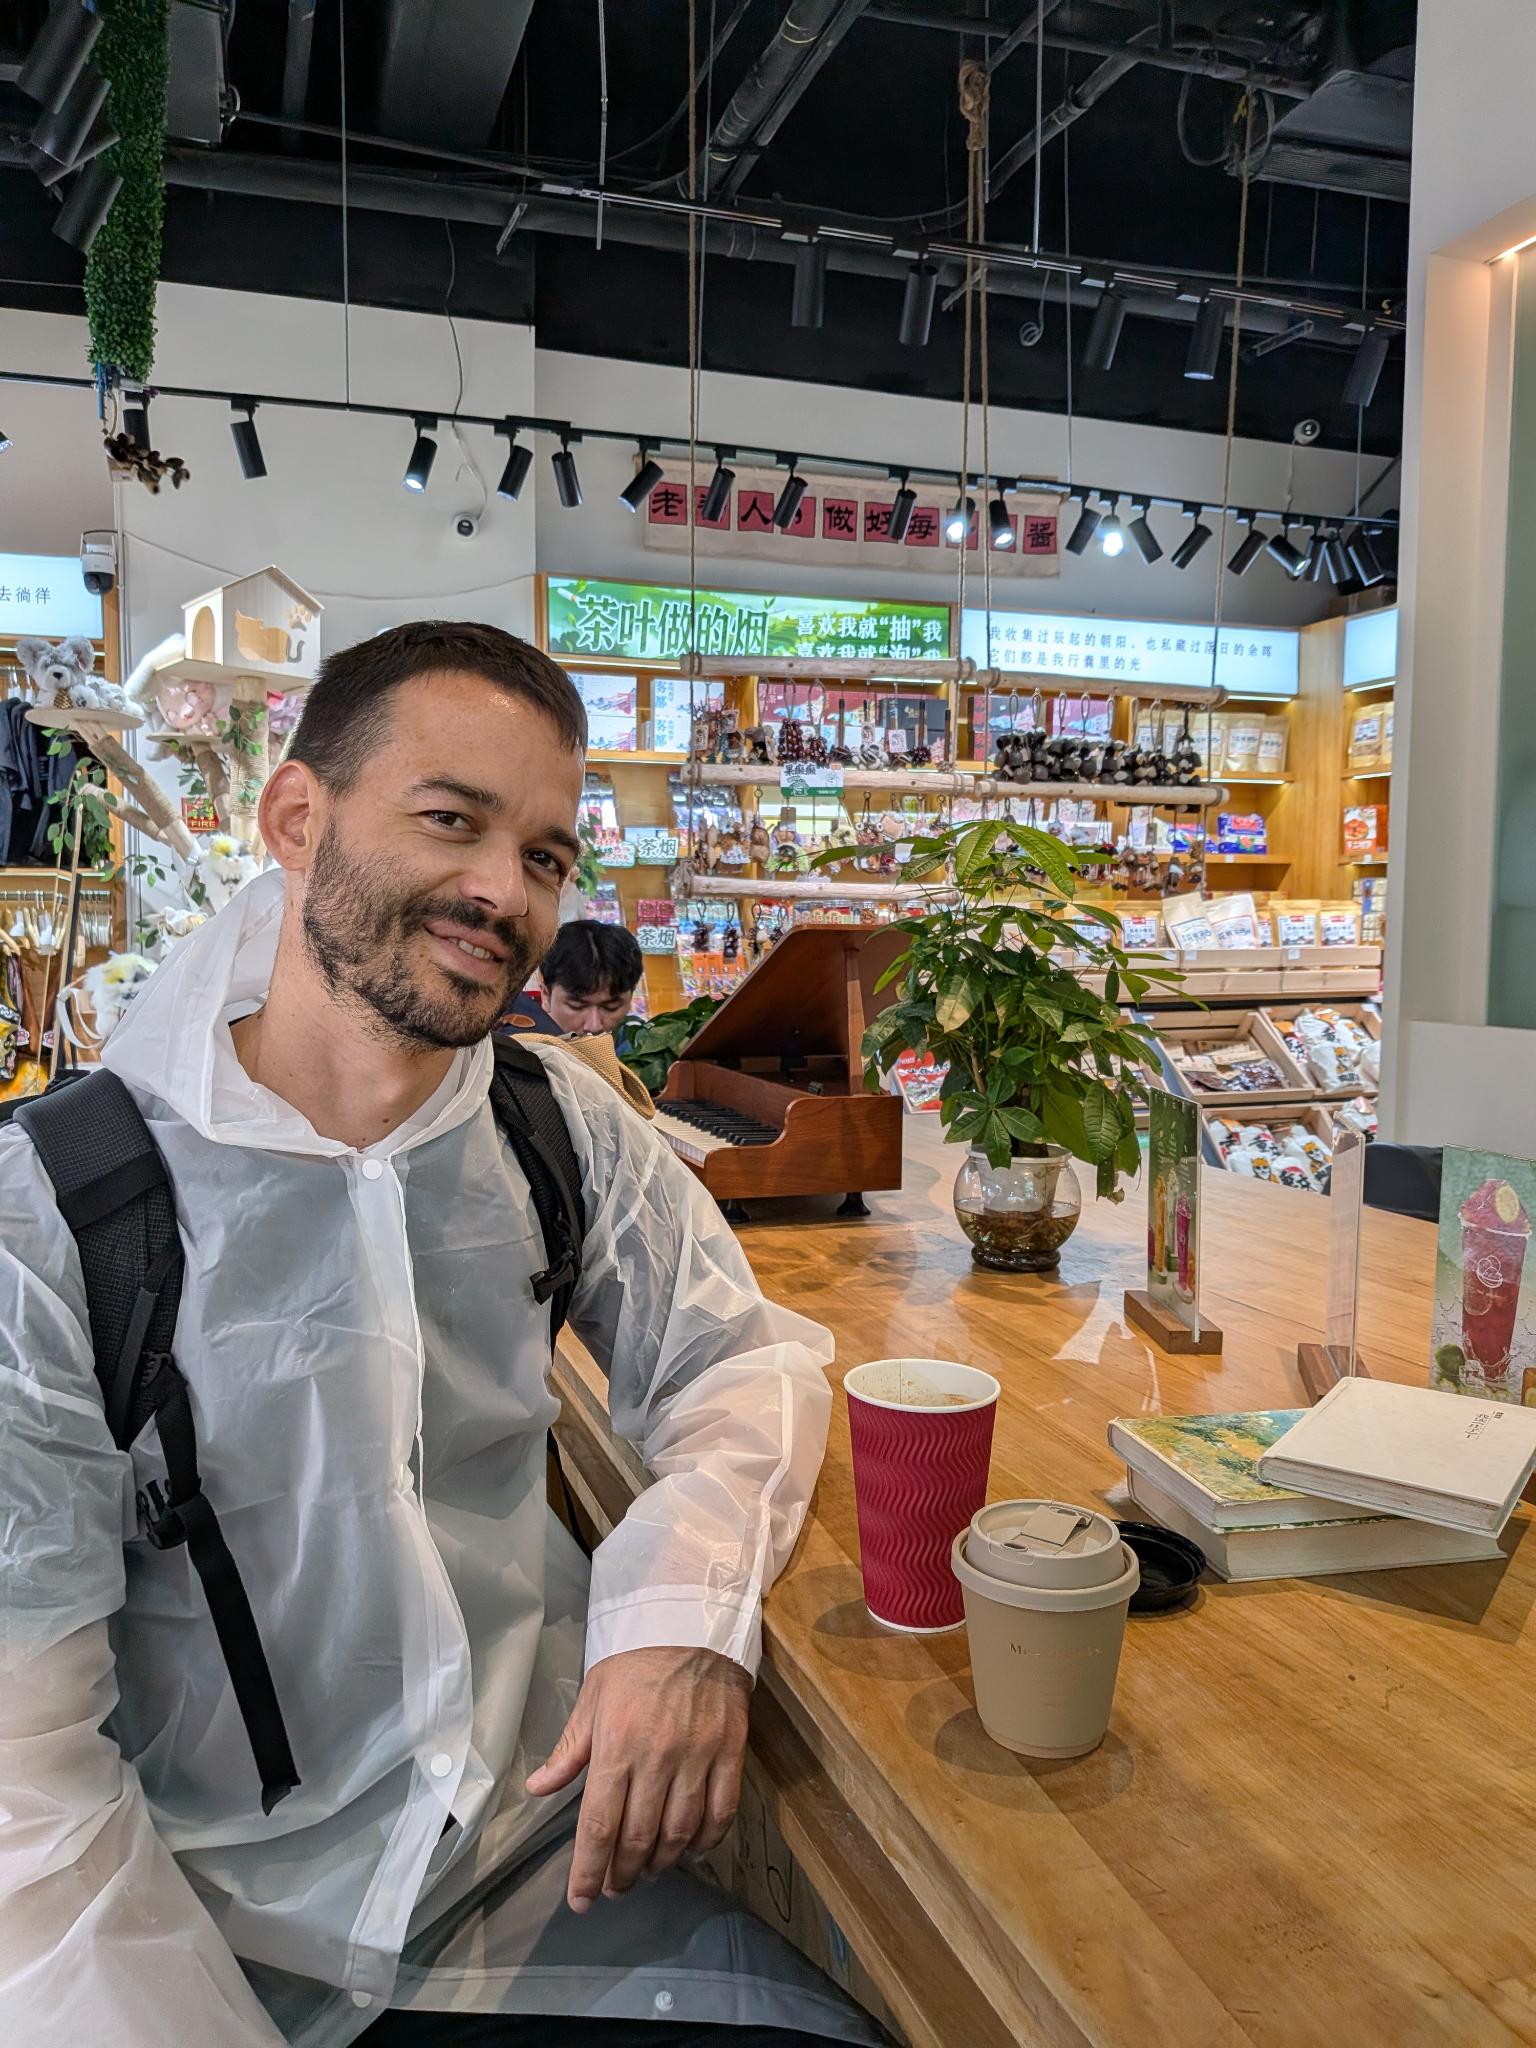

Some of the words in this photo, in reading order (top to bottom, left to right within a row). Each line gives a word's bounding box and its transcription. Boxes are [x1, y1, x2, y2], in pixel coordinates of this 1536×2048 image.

[575, 593, 767, 656] 茶叶做的烟
[641, 838, 677, 857] 茶烟
[640, 928, 675, 947] 茶烟
